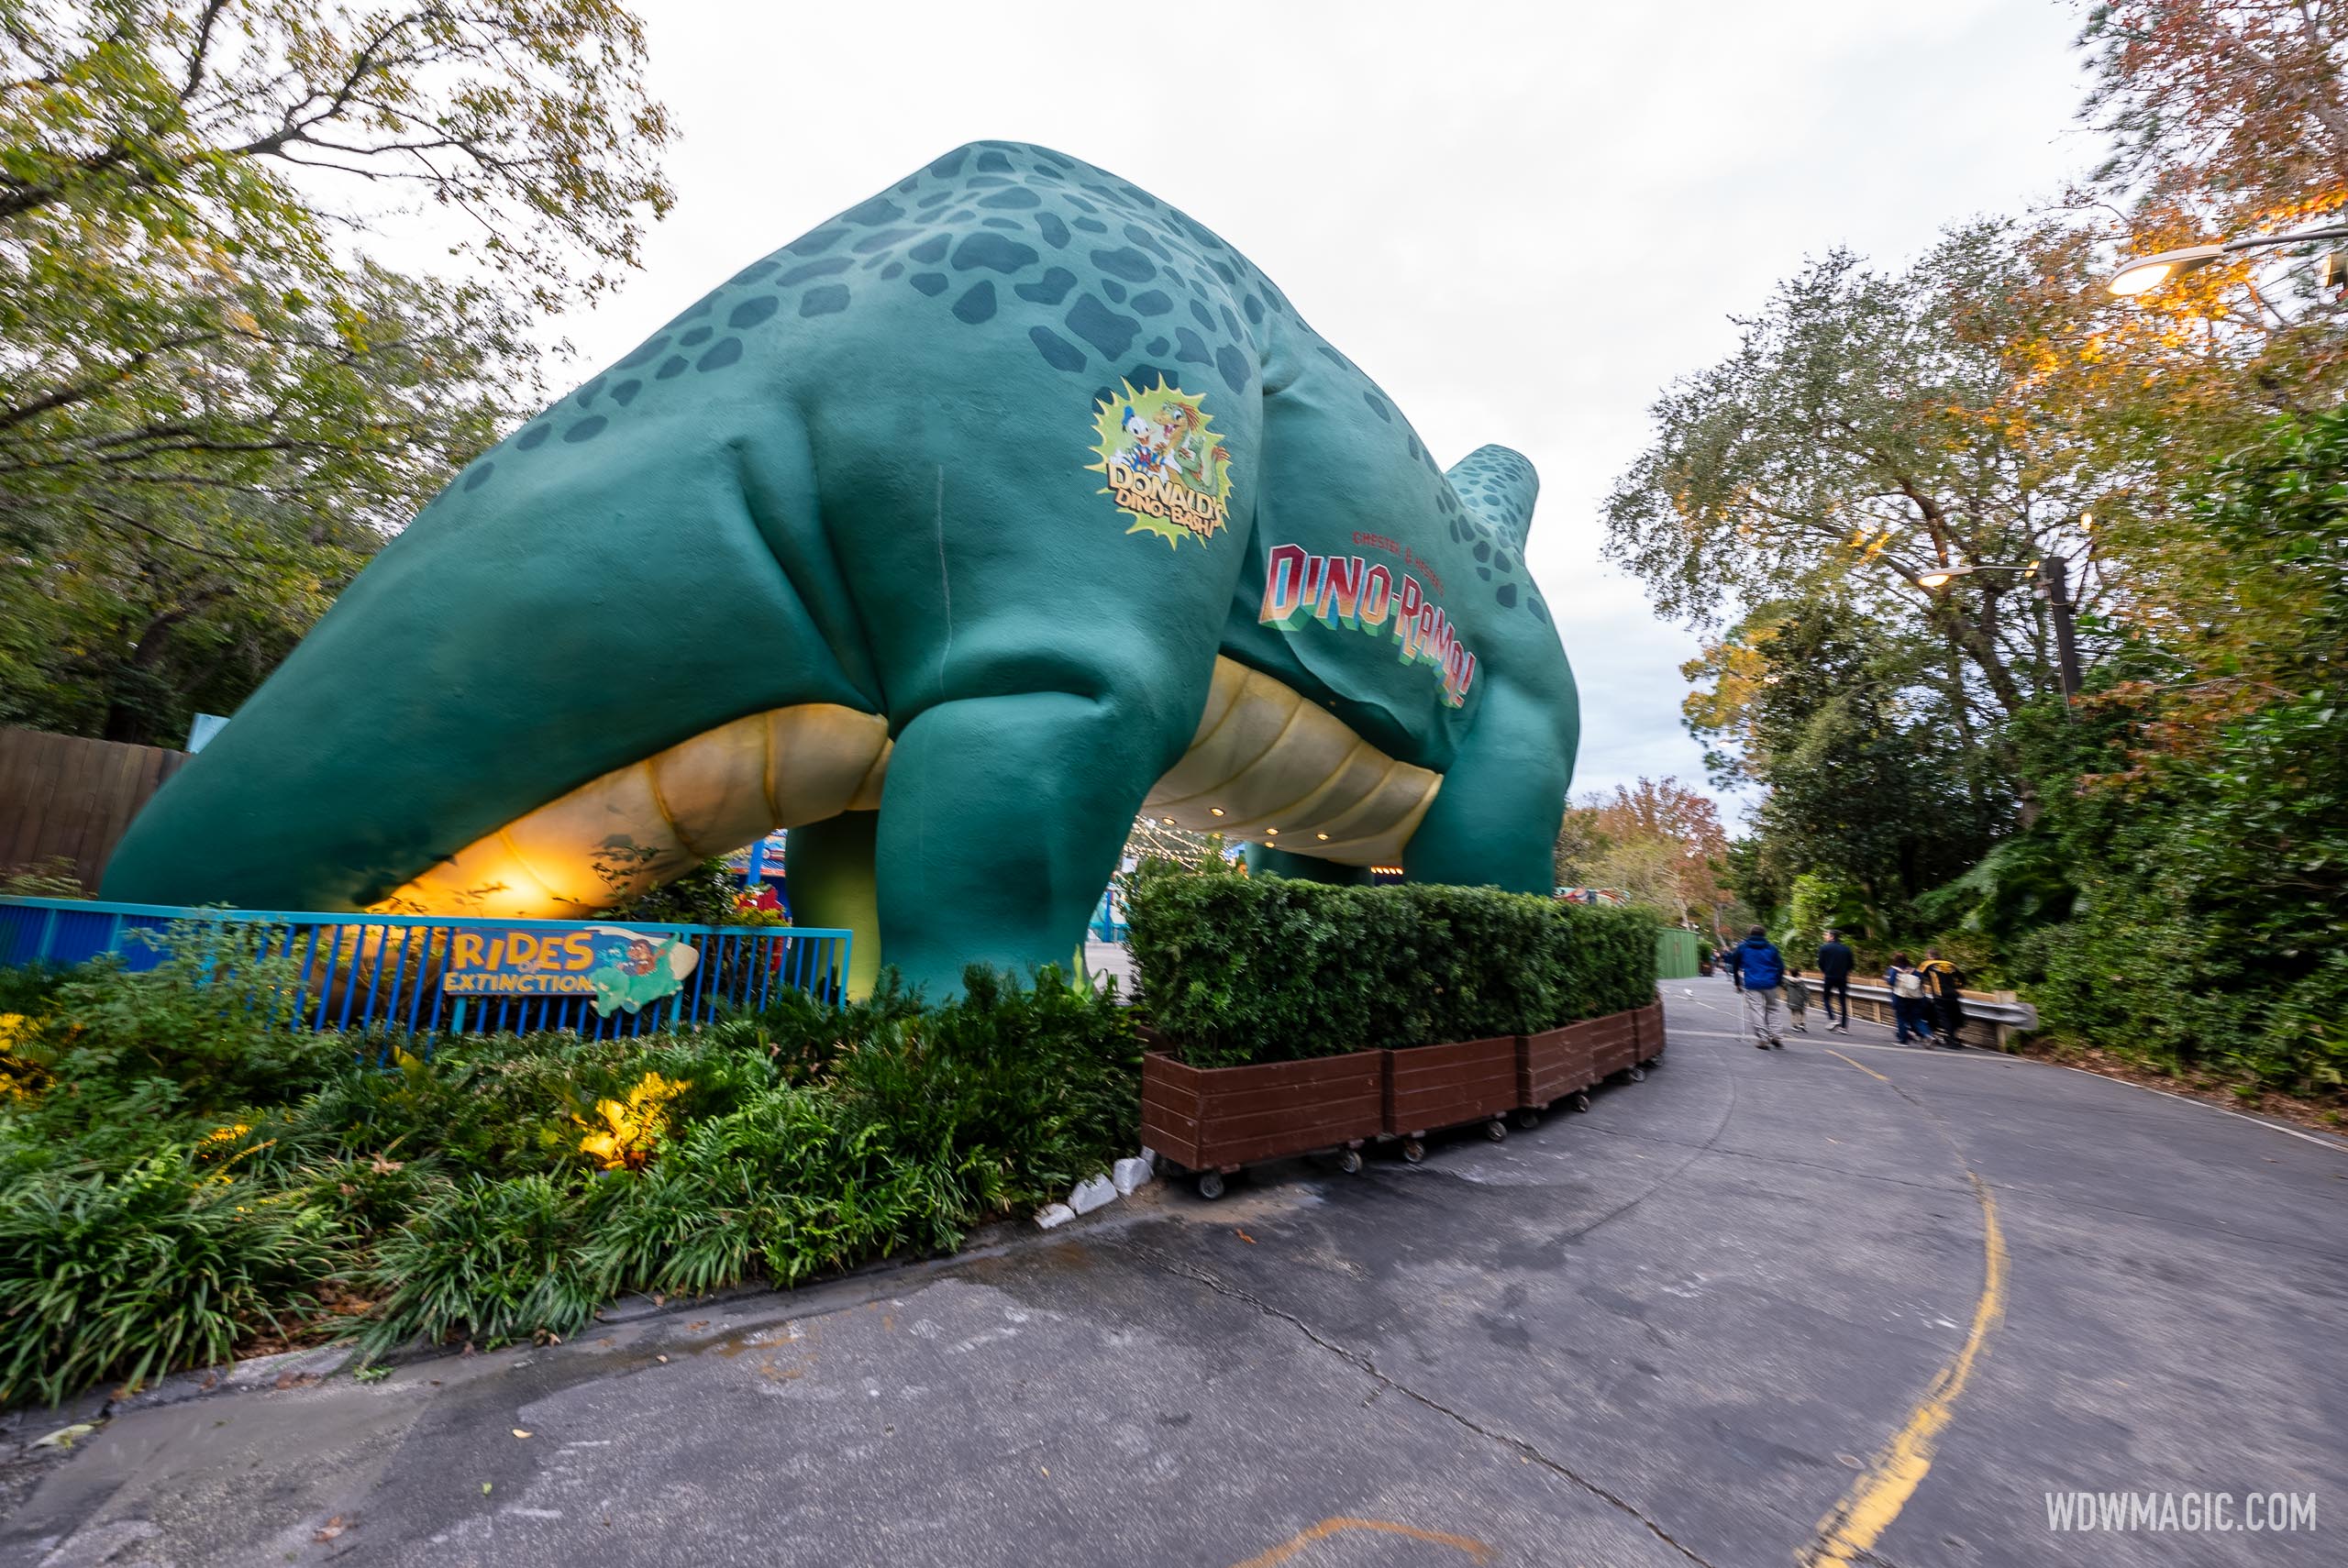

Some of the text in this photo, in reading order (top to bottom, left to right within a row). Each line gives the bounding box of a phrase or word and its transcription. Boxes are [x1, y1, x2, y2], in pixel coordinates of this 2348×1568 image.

[1106, 462, 1224, 528] DONALD'S
[1258, 544, 1476, 710] DINO-RAMA!
[453, 932, 594, 971] RIDES
[443, 972, 594, 993] EXTINCTION
